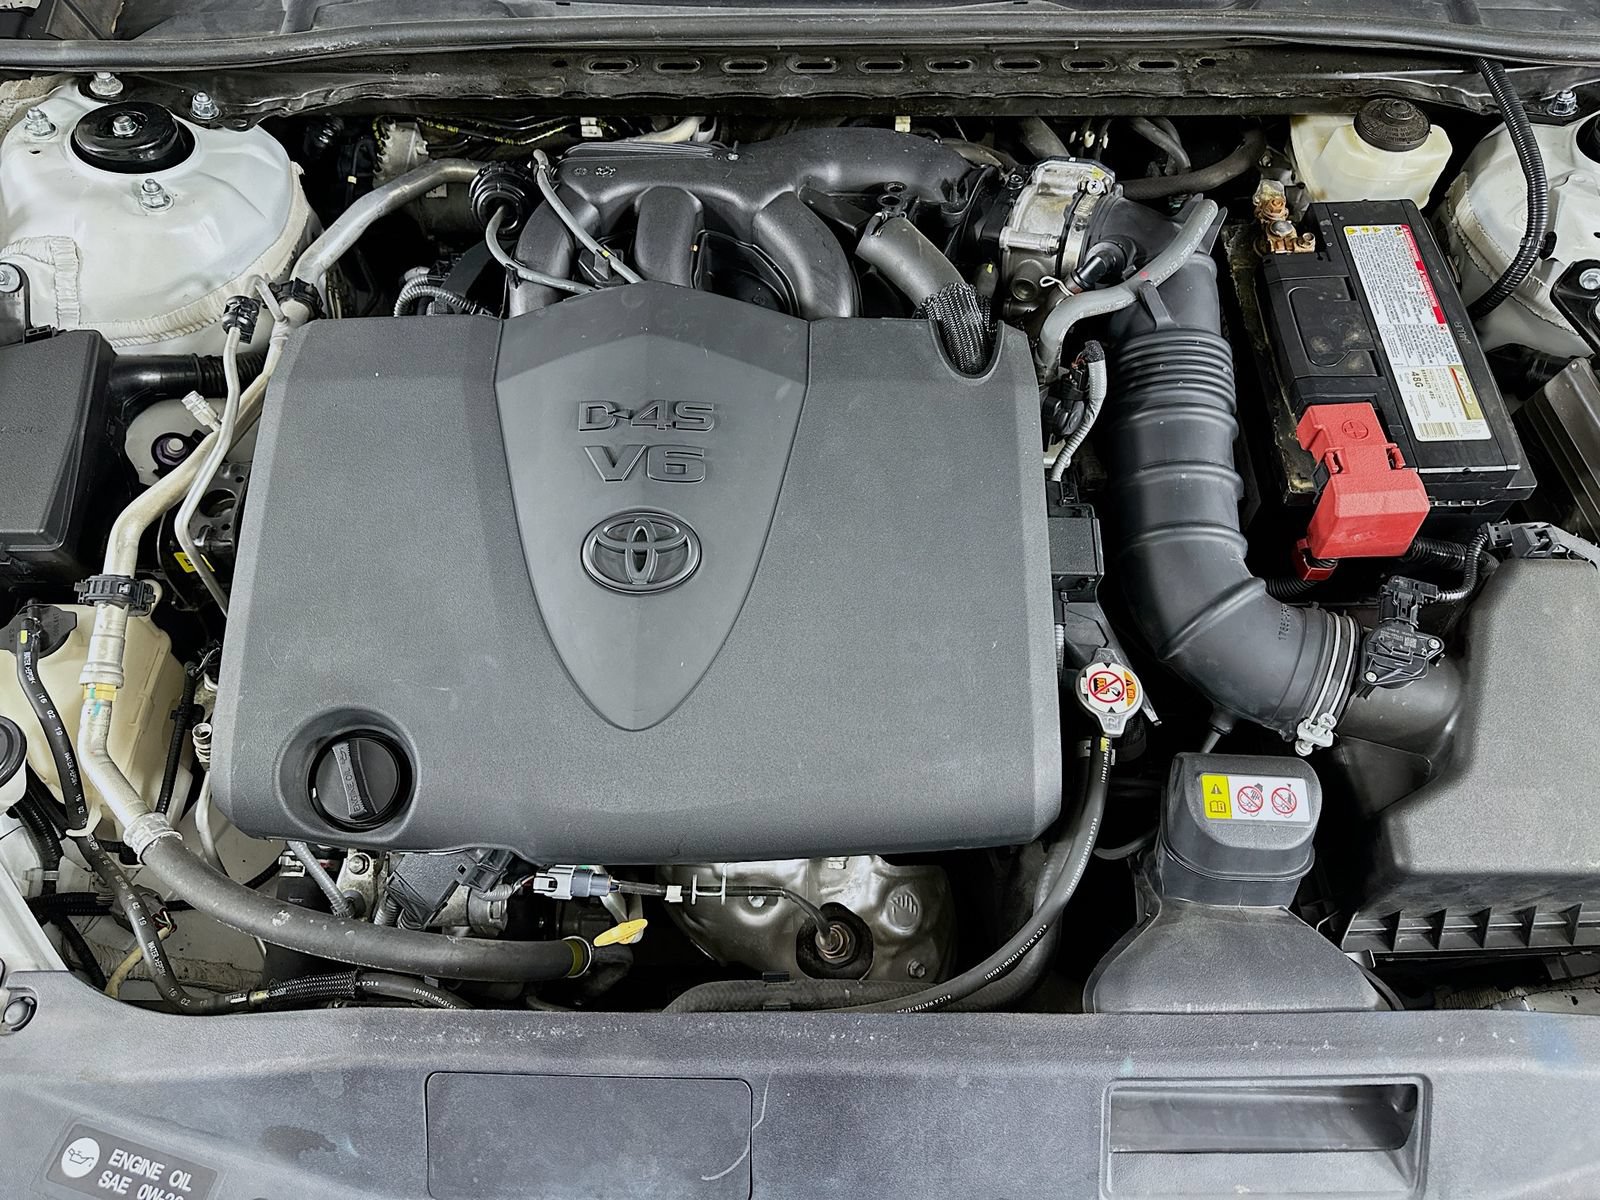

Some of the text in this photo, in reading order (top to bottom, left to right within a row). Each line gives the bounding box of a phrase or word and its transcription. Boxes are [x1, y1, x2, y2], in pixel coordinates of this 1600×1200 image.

[584, 444, 706, 484] V6
[46, 709, 56, 720] 02
[138, 916, 148, 926] 19
[97, 1169, 133, 1195] SAE
[107, 1148, 193, 1192] ENGINE OIL
